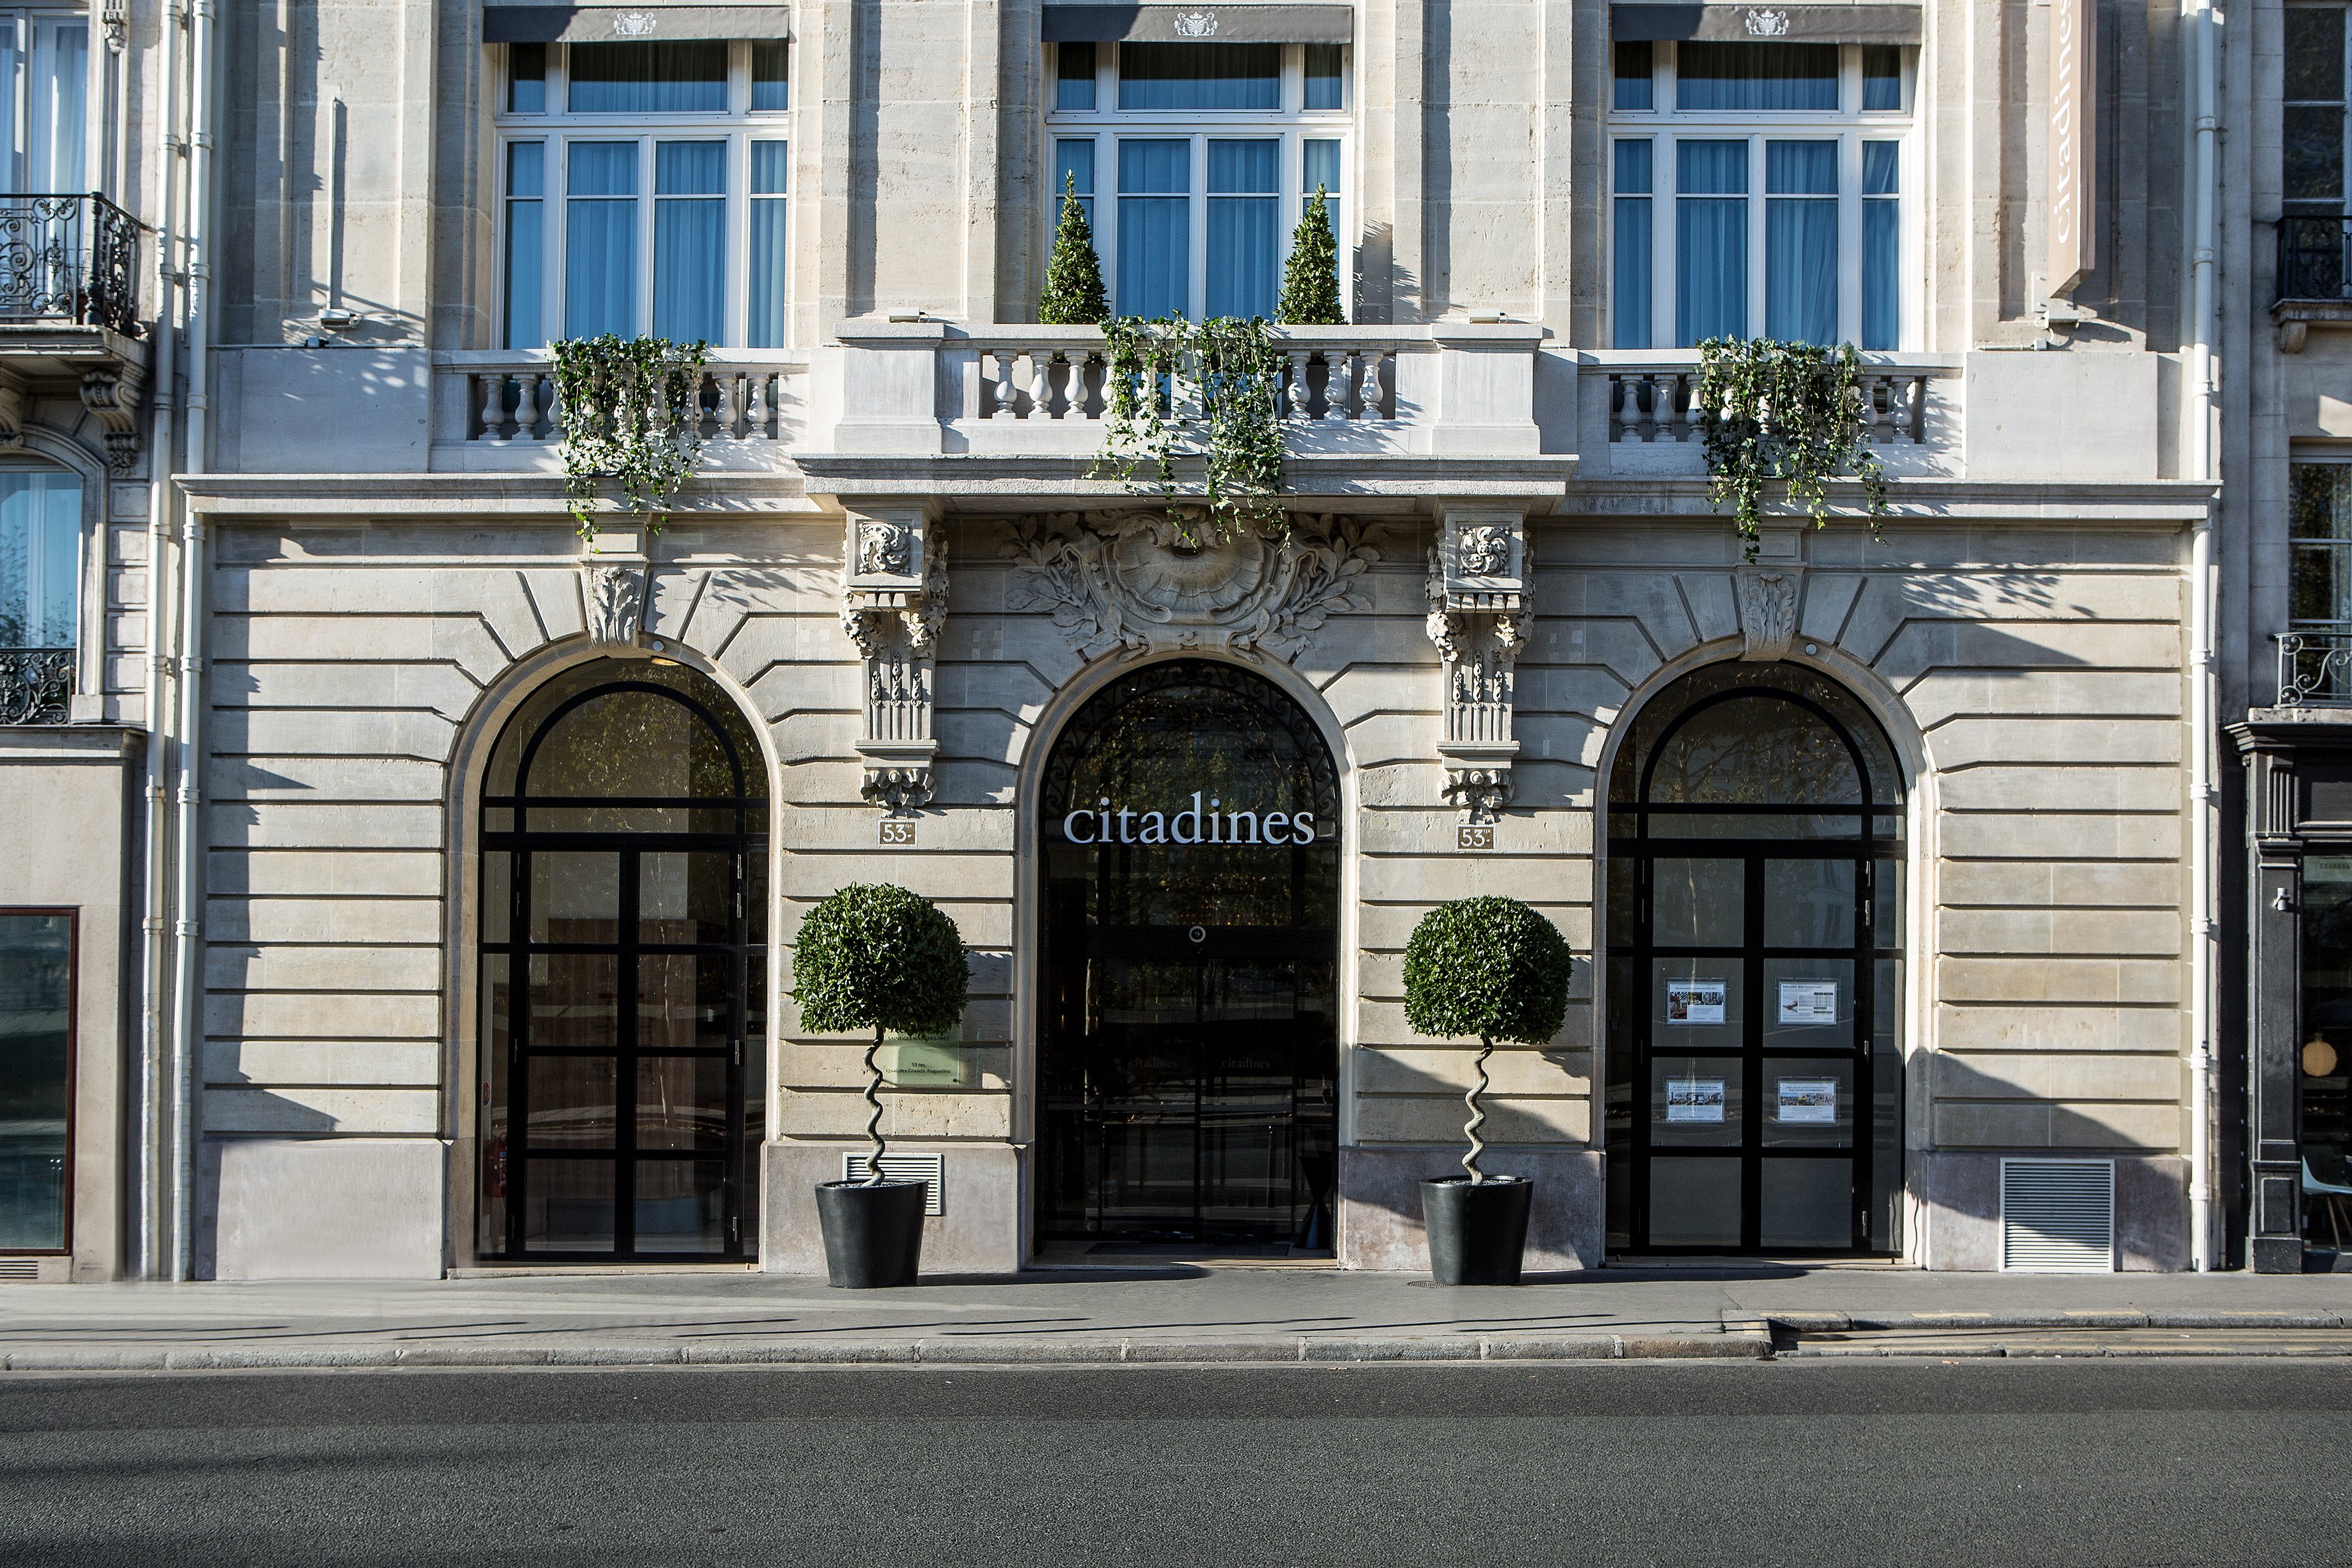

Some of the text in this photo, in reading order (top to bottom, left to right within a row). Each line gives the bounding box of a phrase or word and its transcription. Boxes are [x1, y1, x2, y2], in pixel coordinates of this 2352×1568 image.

[2052, 0, 2072, 244] citadines
[1063, 791, 1314, 845] citadines
[1221, 1057, 1270, 1068] citadines
